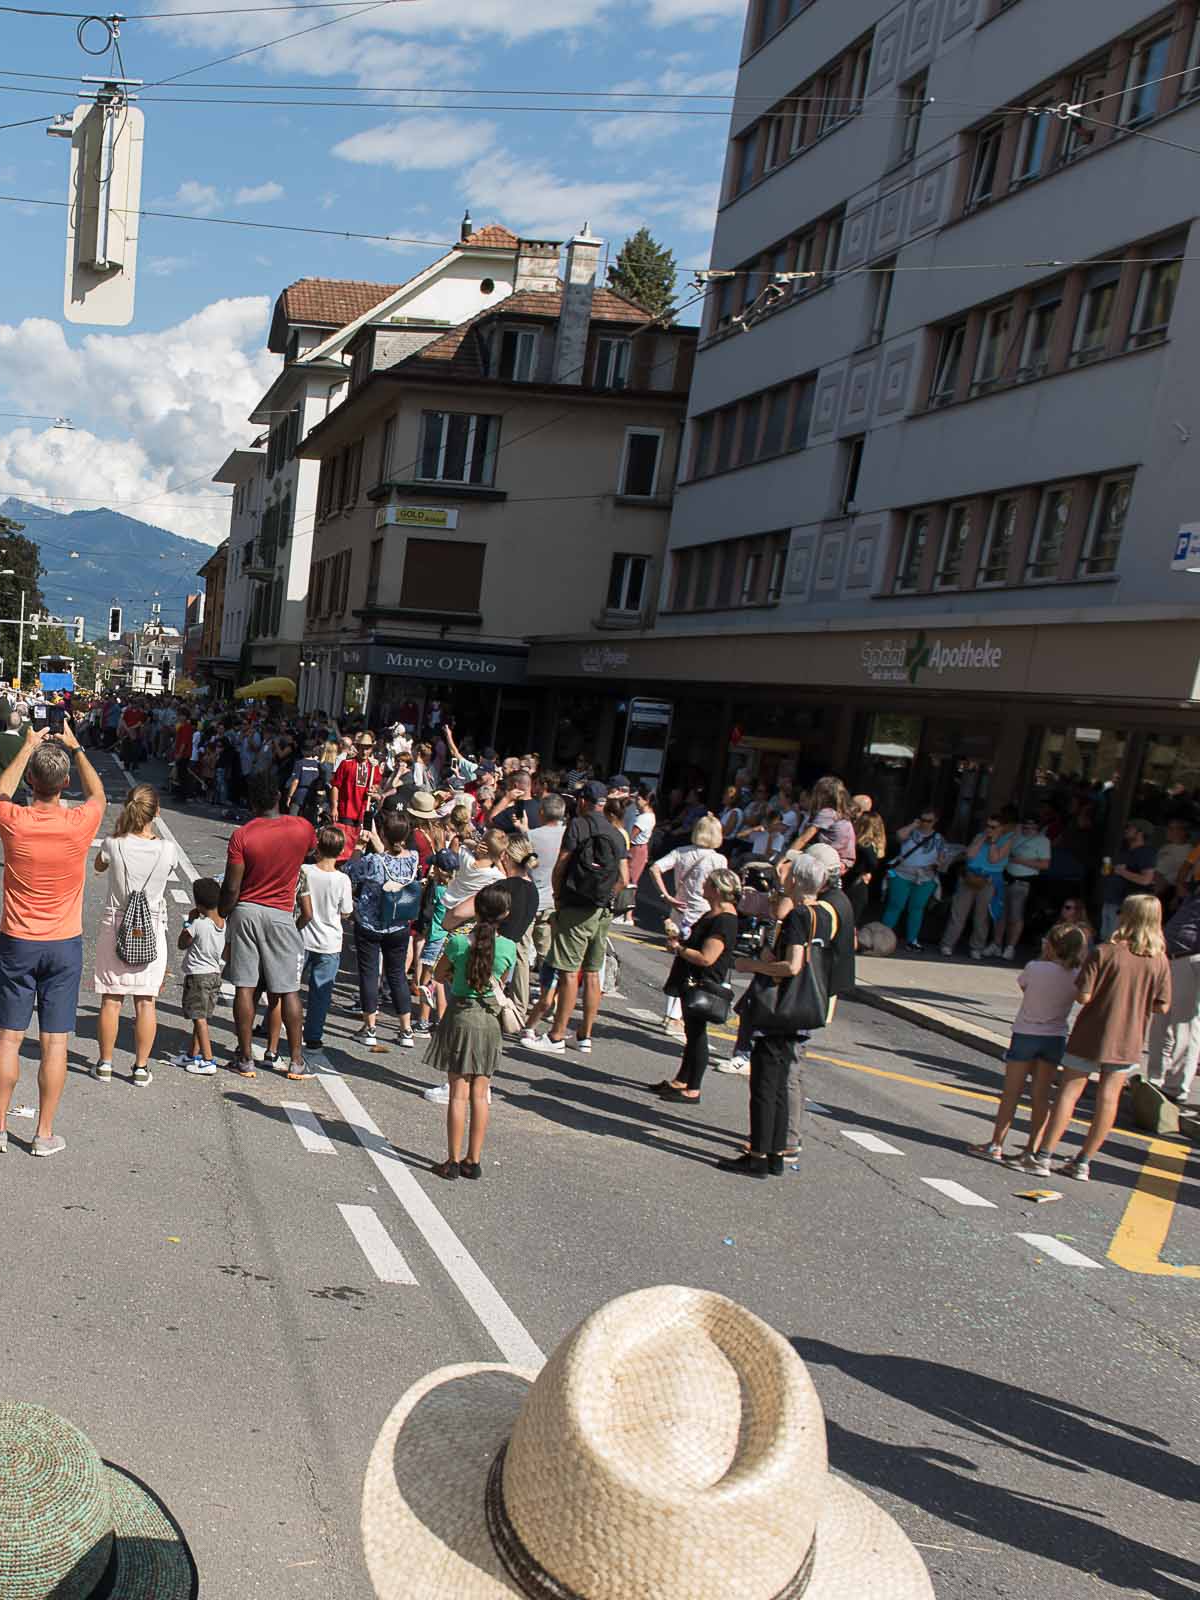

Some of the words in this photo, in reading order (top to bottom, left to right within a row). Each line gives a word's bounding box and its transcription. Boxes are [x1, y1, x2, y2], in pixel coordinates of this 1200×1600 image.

[400, 510, 425, 519] GOLD
[385, 652, 433, 669] Marc
[438, 656, 497, 673] O'Polo
[928, 638, 1002, 675] Apotheke
